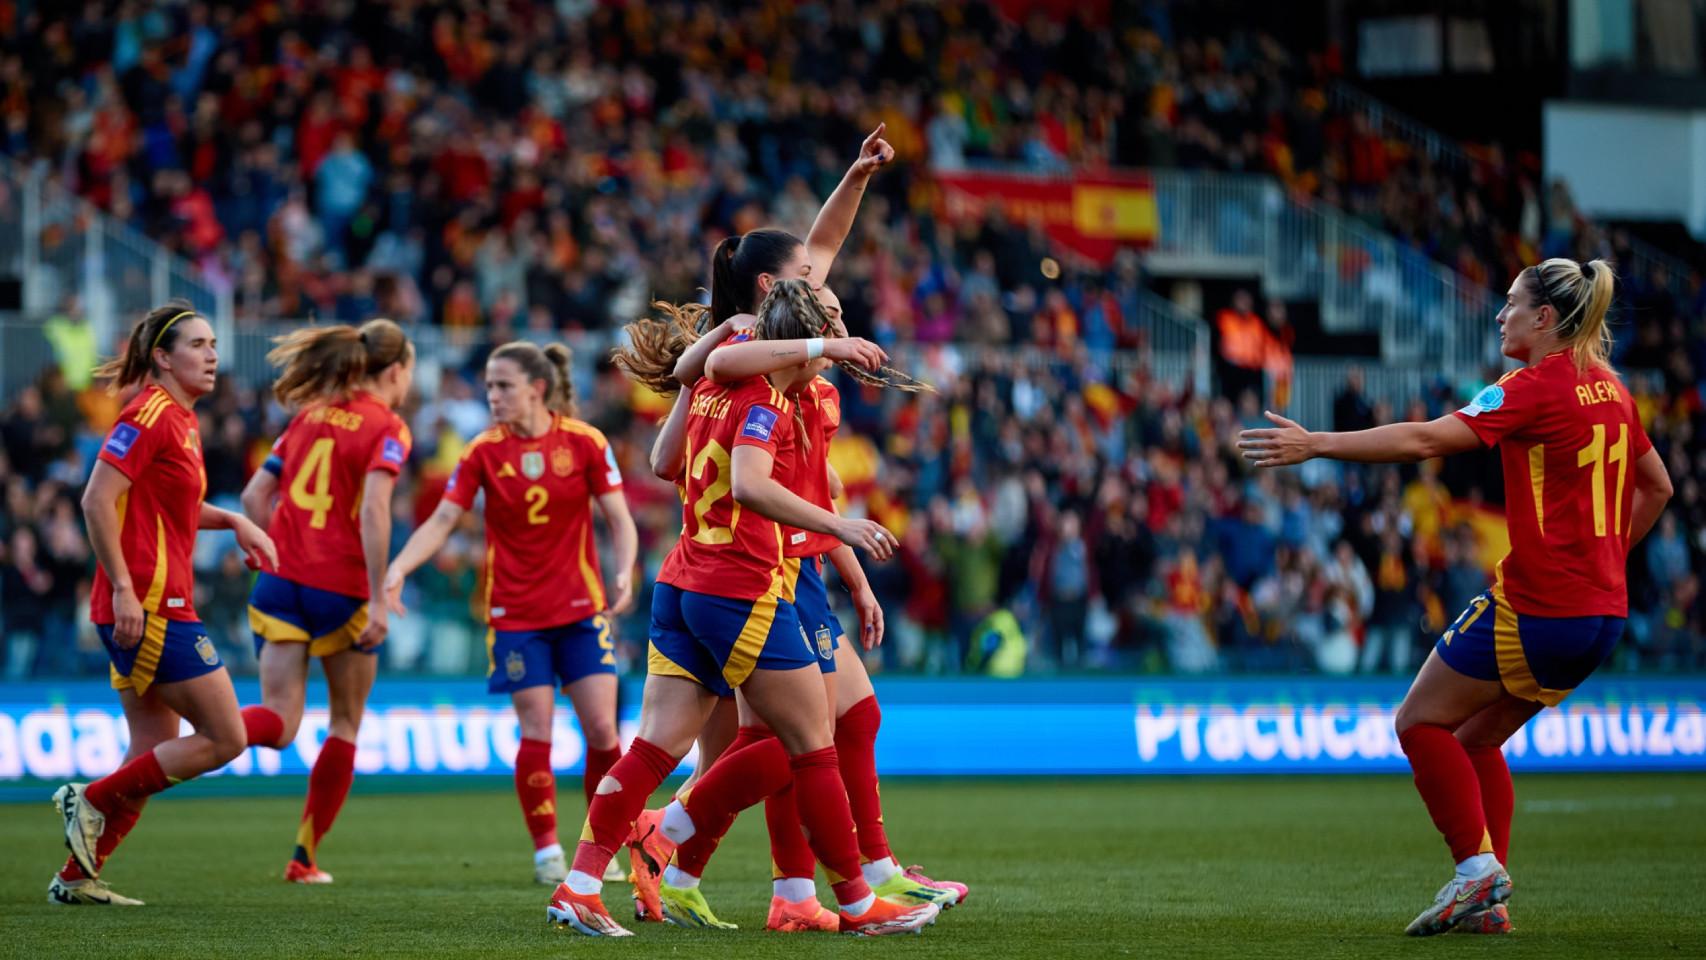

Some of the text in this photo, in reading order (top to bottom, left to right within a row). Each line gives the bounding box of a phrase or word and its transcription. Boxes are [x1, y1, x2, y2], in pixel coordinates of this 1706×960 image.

[290, 438, 336, 529] 4
[525, 485, 549, 524] 2
[684, 437, 734, 545] 2
[1577, 423, 1628, 537] 11
[592, 615, 614, 649] 2
